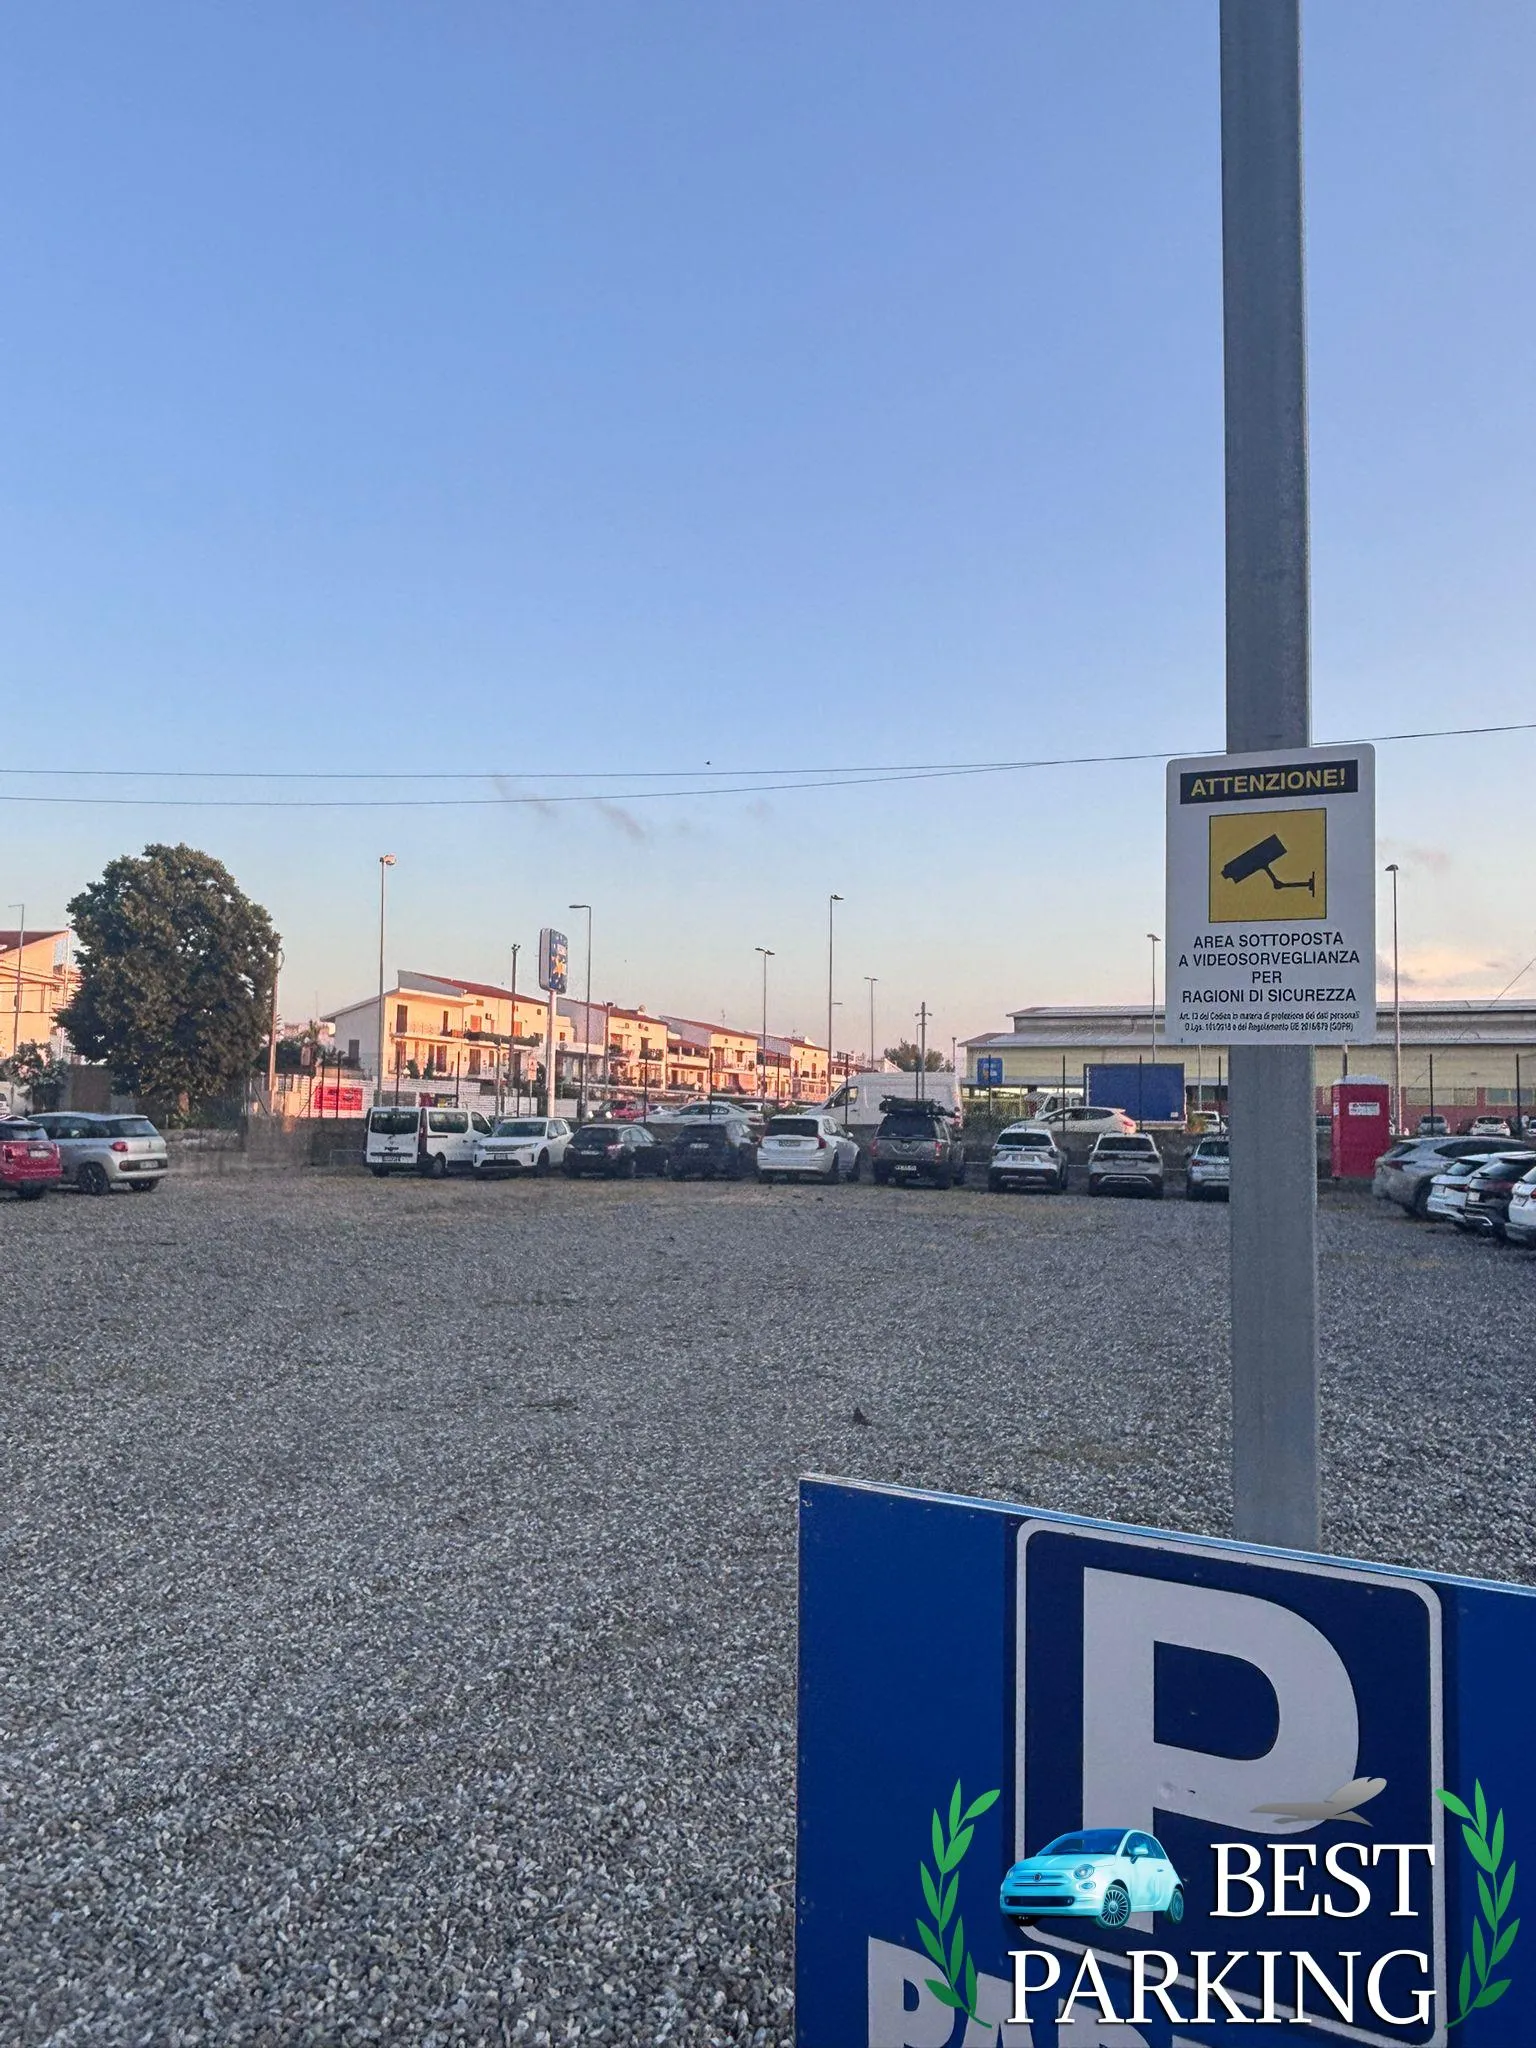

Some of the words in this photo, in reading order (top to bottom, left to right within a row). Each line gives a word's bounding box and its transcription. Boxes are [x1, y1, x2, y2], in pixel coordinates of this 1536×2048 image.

[1190, 768, 1346, 797] ATTENZIONE!
[1193, 935, 1235, 949] AREA
[1238, 931, 1344, 948] SOTTOPOSTA
[1178, 954, 1189, 967] A
[1193, 950, 1360, 967] VIDEOSORVEGLIANZA
[1251, 970, 1283, 984] PER
[1182, 989, 1245, 1003] RAGIONI
[1249, 989, 1264, 1002] DI
[1267, 987, 1357, 1003] SICUREZZA
[1083, 1566, 1360, 1934] P
